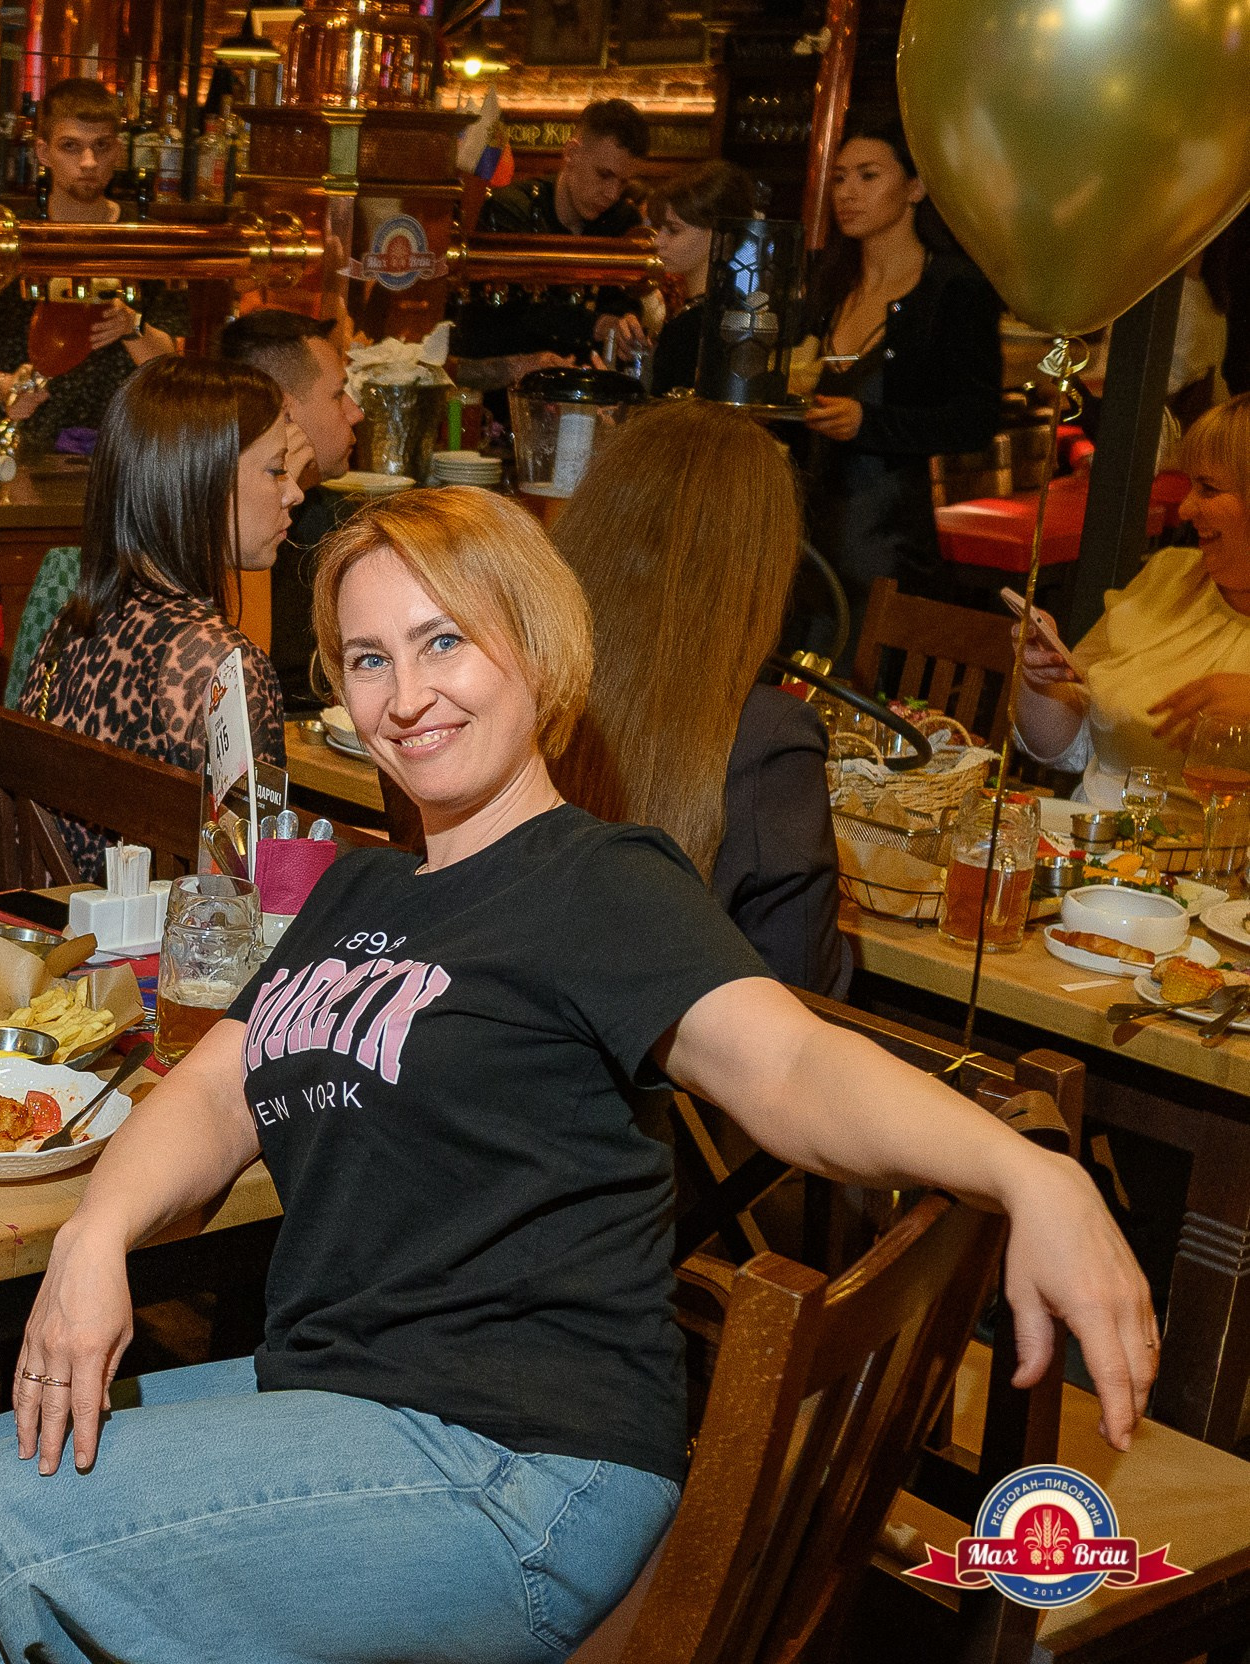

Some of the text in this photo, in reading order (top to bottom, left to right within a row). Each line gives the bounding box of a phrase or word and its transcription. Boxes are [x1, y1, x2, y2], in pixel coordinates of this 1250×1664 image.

[257, 784, 282, 806] ДАРОК!
[334, 931, 407, 954] 1898
[252, 1080, 363, 1130] EW YORK
